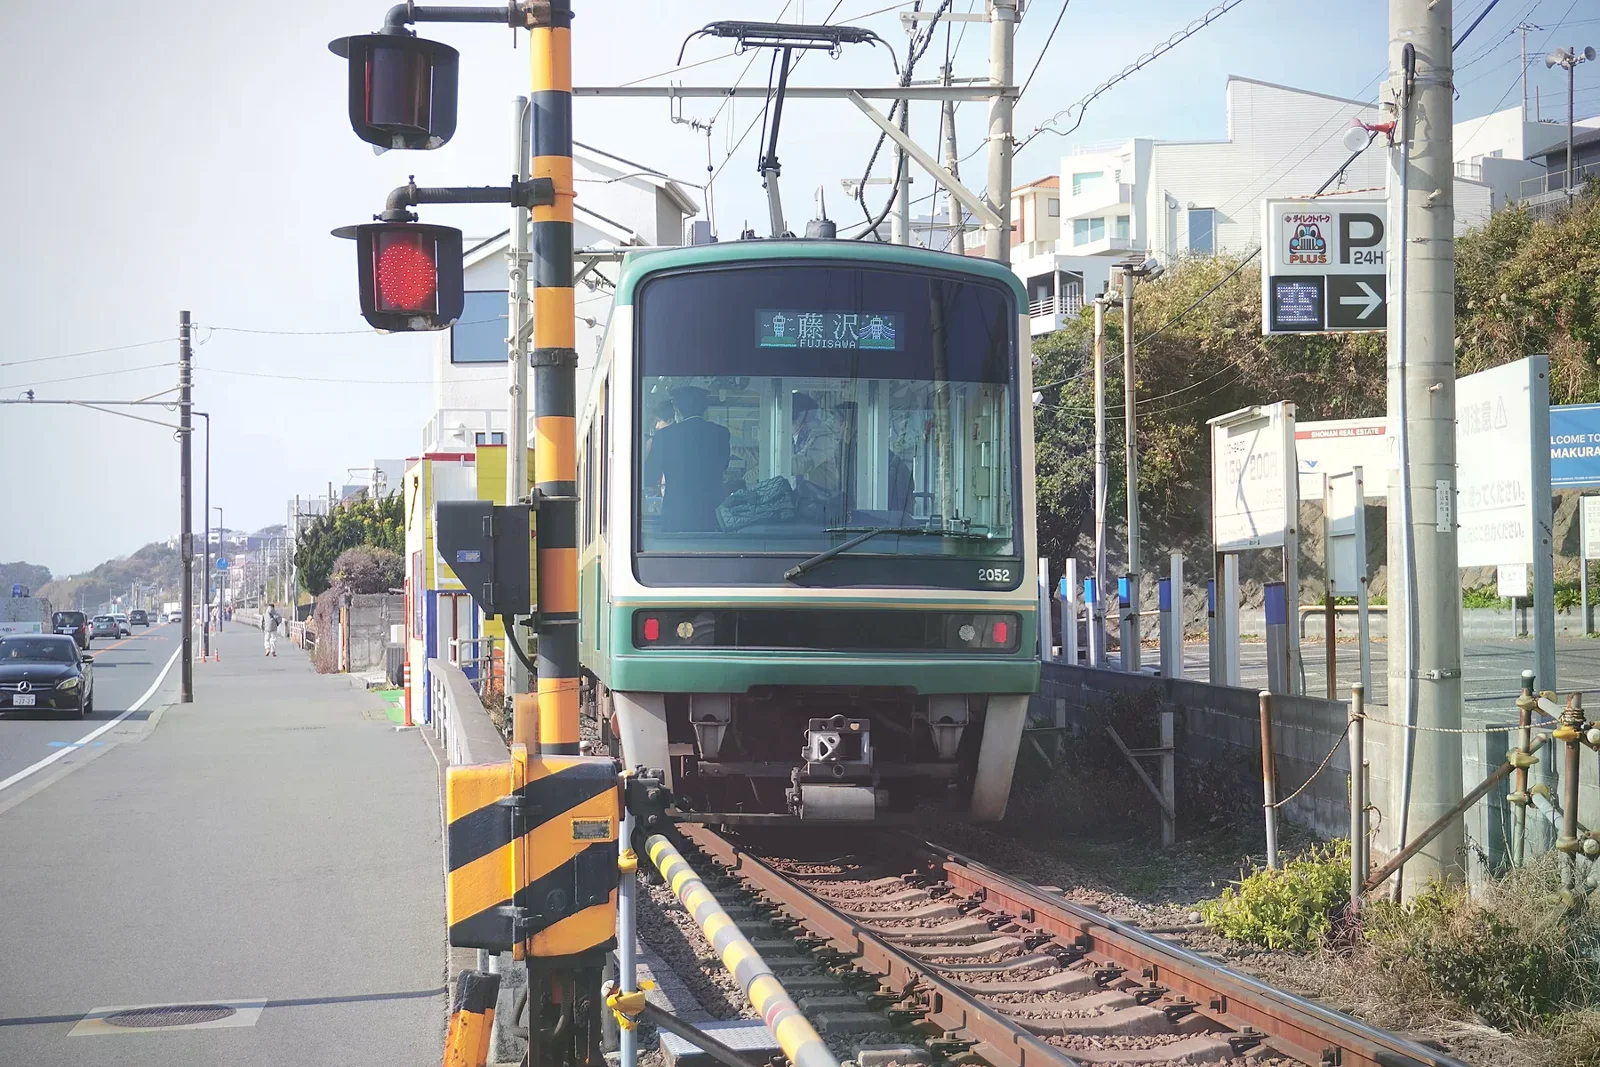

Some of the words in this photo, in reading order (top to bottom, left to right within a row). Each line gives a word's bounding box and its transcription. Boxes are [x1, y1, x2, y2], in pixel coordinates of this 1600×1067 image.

[1293, 214, 1331, 223] ダイレクトパーク
[1339, 212, 1385, 264] P
[1289, 254, 1328, 264] PLUS
[1353, 250, 1384, 265] 24H
[1276, 282, 1318, 322] 空
[796, 312, 859, 340] 藤沢
[799, 339, 856, 349] FUJISAWA
[1311, 429, 1338, 438] SHONAN
[1339, 428, 1356, 436] REAL
[1356, 427, 1379, 435] ESTATE
[978, 568, 1010, 582] 2052
